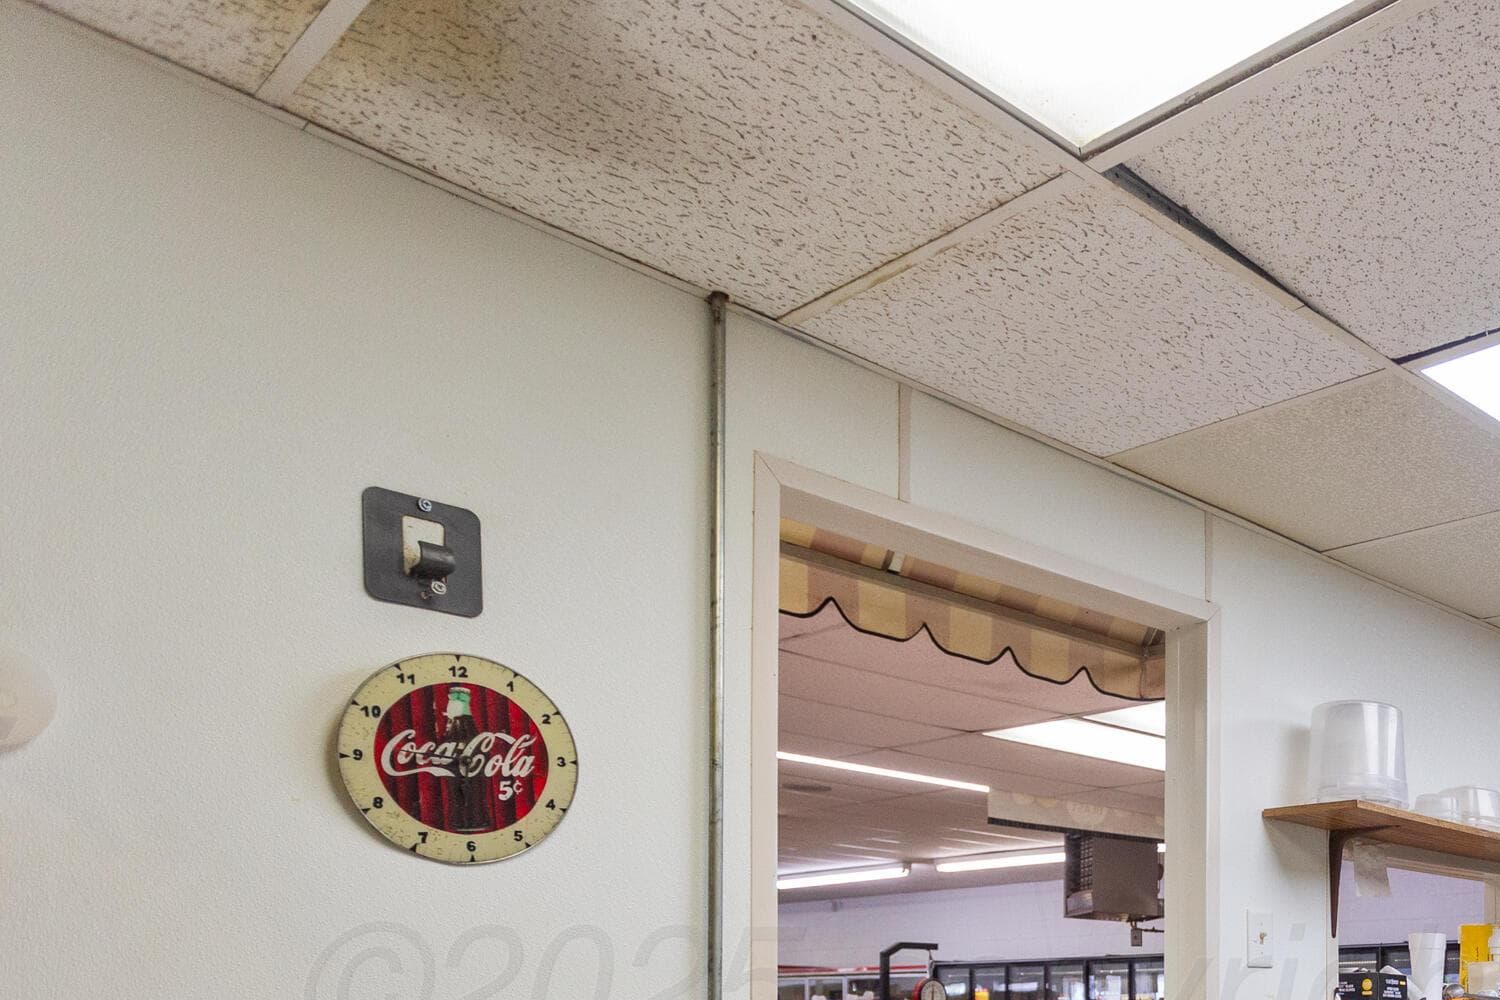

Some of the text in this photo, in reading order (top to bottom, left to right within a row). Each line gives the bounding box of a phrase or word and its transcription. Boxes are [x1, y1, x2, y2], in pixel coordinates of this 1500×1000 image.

[448, 666, 469, 678] 12
[396, 674, 415, 684] 11
[506, 681, 515, 691] 1
[360, 706, 381, 718] 10
[542, 714, 551, 724] 2
[352, 749, 363, 760] 9
[380, 729, 537, 778] Coca-Cola
[557, 757, 566, 766] 3
[372, 797, 384, 809] 8
[545, 799, 556, 810] 4
[418, 831, 428, 844] 7
[513, 830, 523, 842] 5
[467, 841, 476, 852] 6
